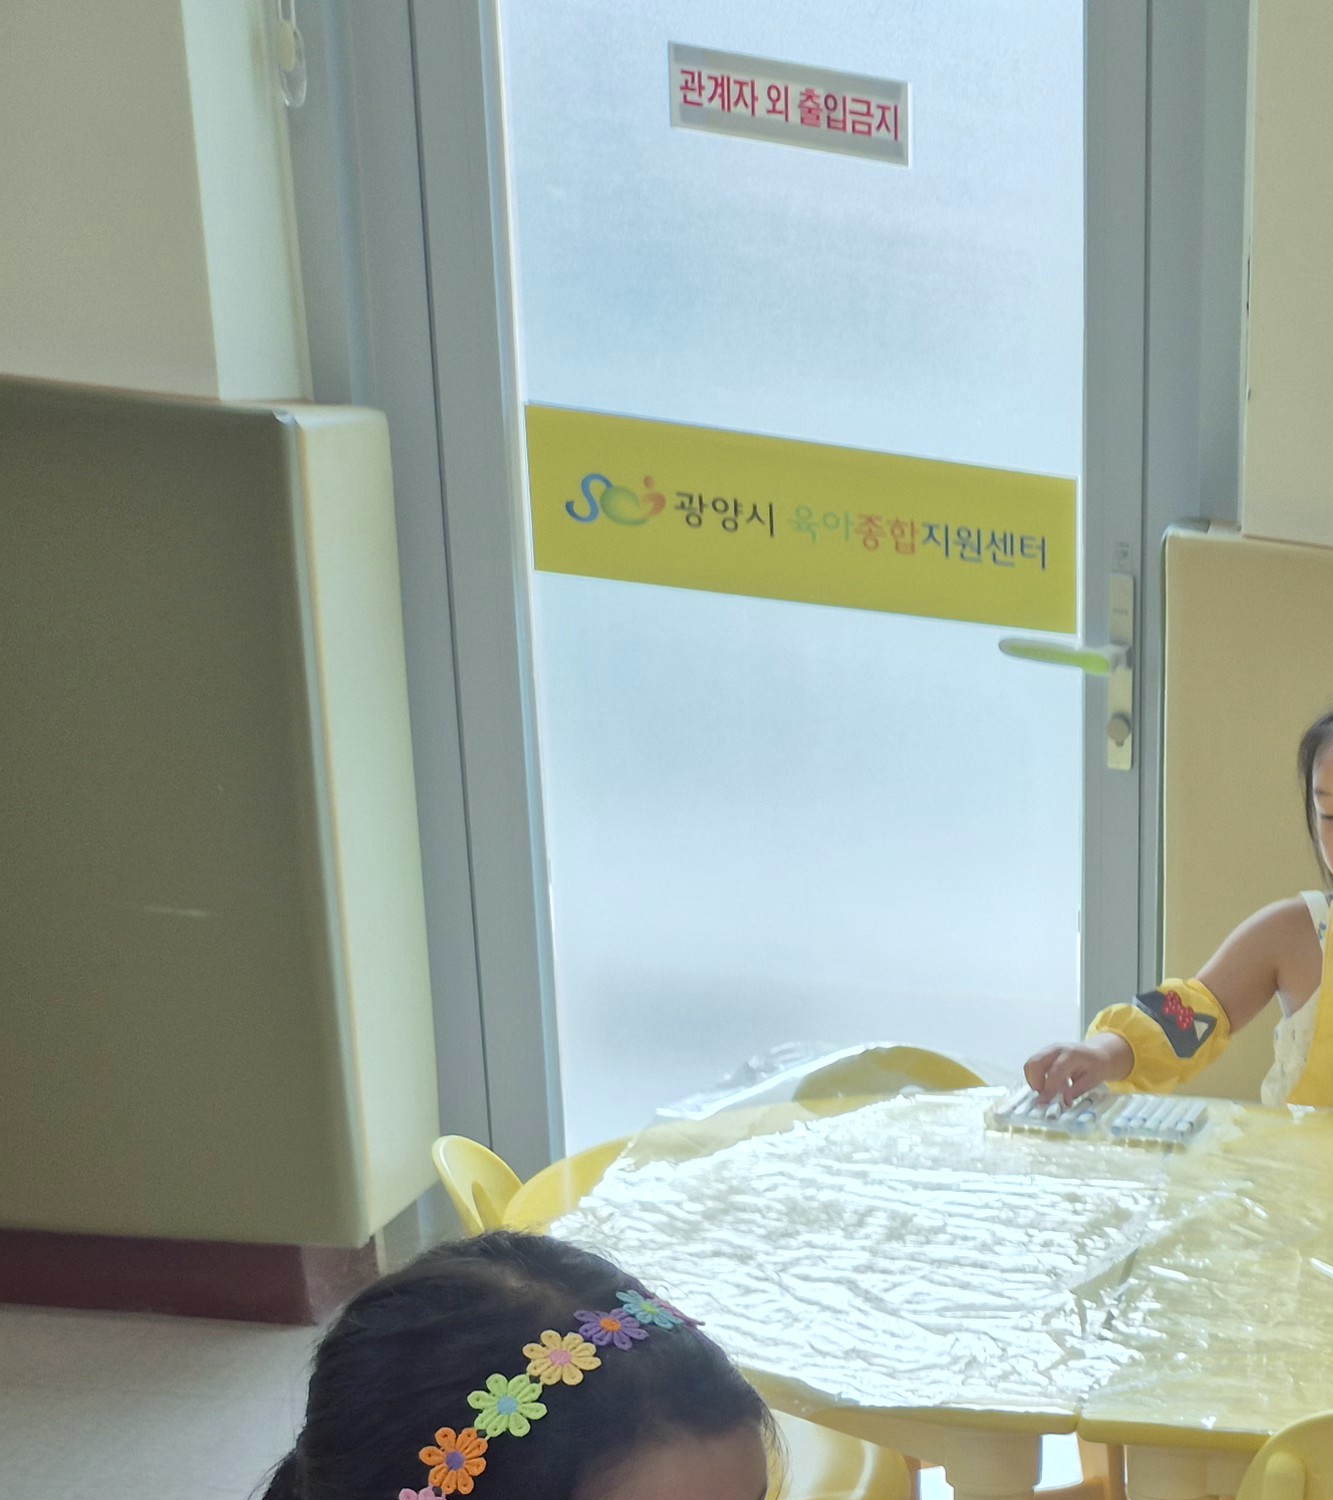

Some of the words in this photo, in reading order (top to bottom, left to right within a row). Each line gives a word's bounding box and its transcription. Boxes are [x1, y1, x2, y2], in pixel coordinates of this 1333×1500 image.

[680, 68, 758, 117] 관계자
[766, 84, 789, 123] 외
[798, 87, 899, 141] 출입금지
[674, 491, 775, 538] 광양시
[786, 505, 1047, 570] 육아종합지원센터
